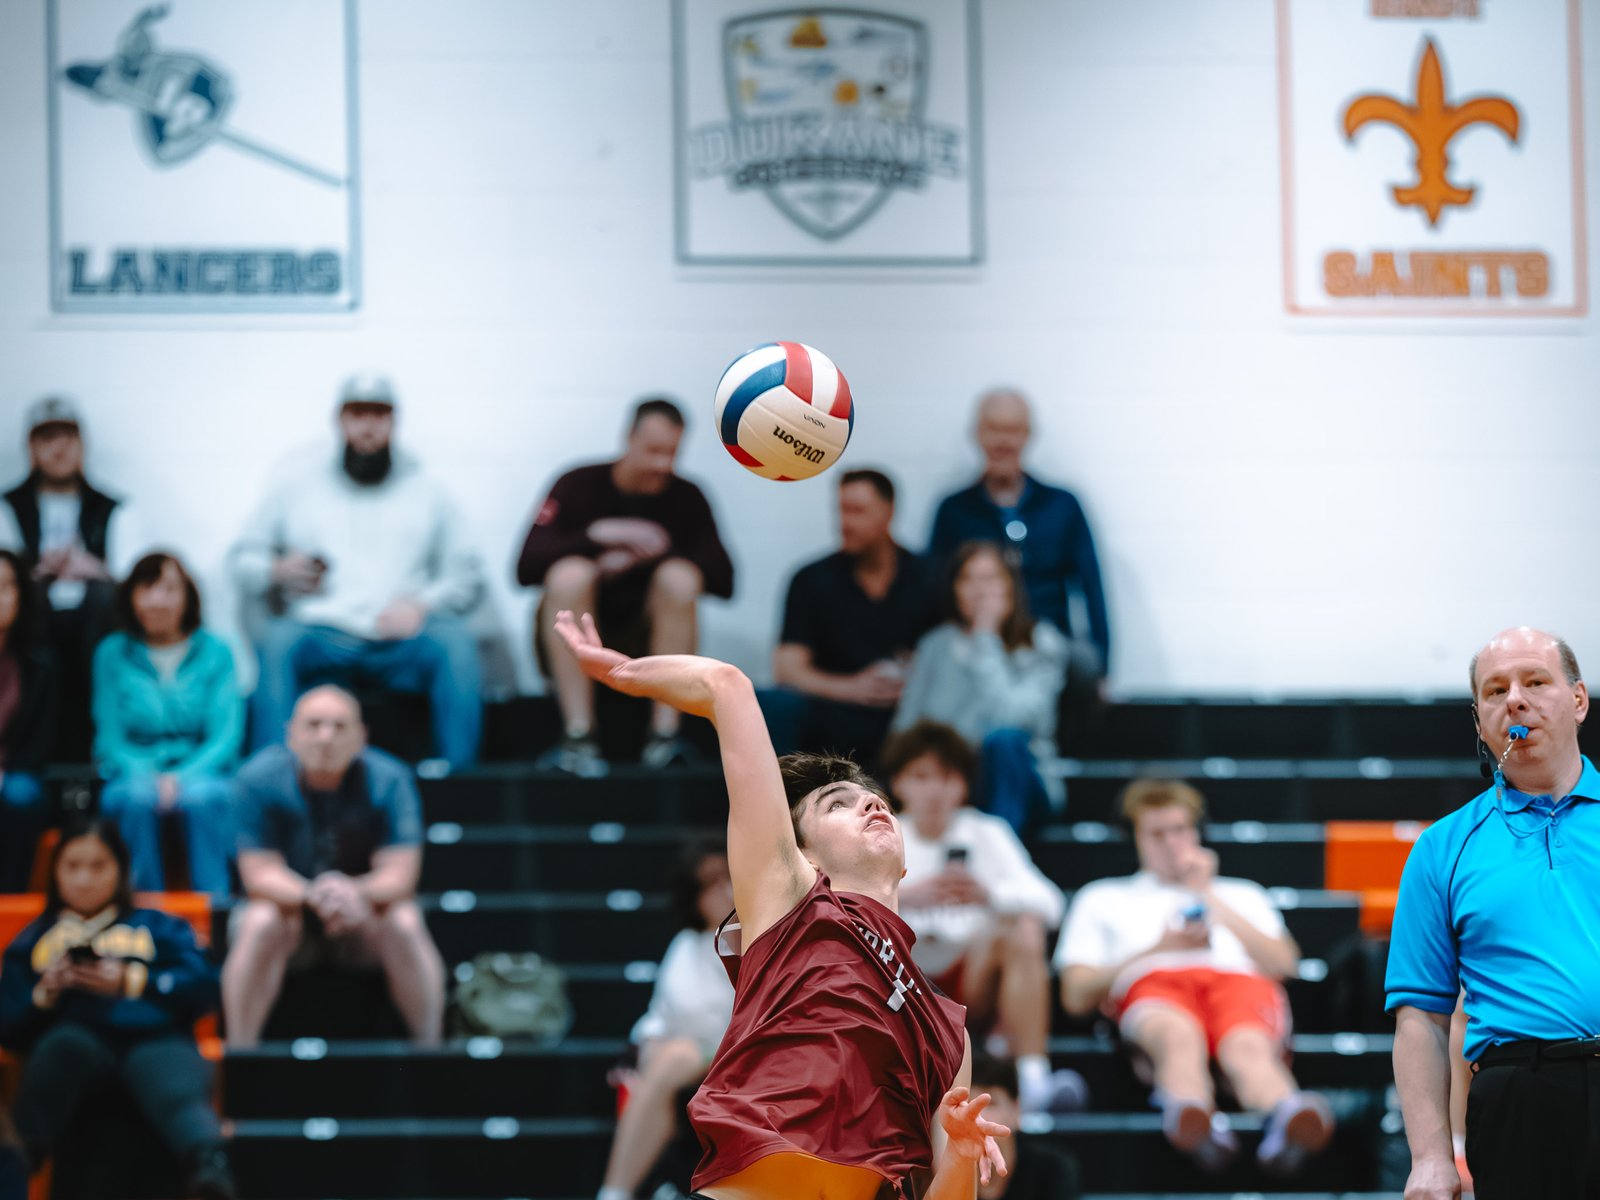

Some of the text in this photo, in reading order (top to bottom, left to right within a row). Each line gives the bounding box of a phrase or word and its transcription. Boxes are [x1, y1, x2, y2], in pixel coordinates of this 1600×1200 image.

[69, 250, 341, 294] LANCERS
[1323, 250, 1549, 297] SAINTS
[773, 425, 826, 464] Wilson
